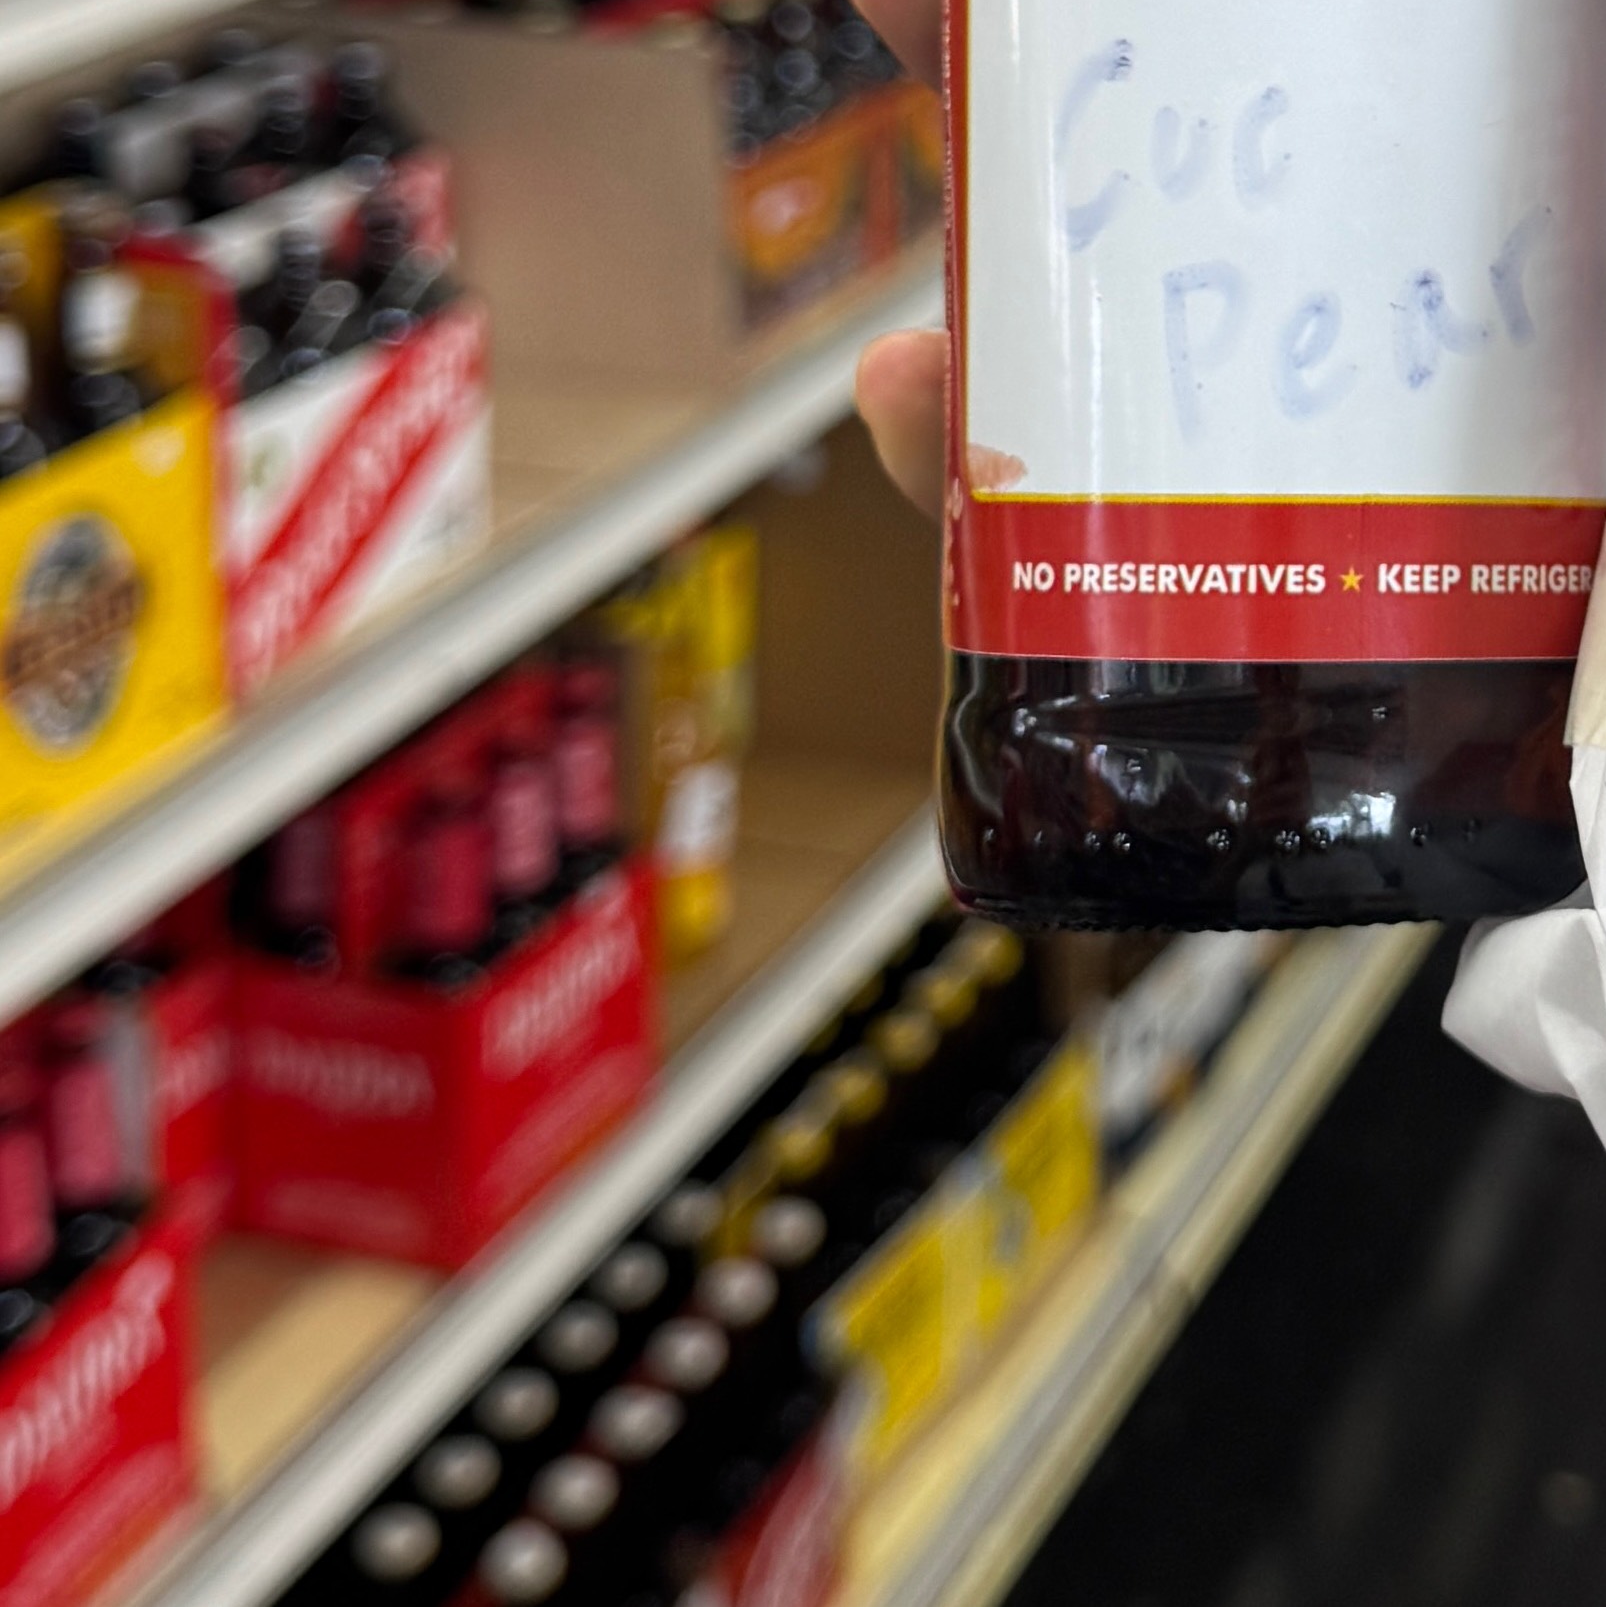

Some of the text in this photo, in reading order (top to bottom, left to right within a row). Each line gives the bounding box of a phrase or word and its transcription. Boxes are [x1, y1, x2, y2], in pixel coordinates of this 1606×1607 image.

[1160, 204, 1554, 446] Pear
[1012, 561, 1593, 595] NO PRESERVATIVES KEEP REFRIGER
